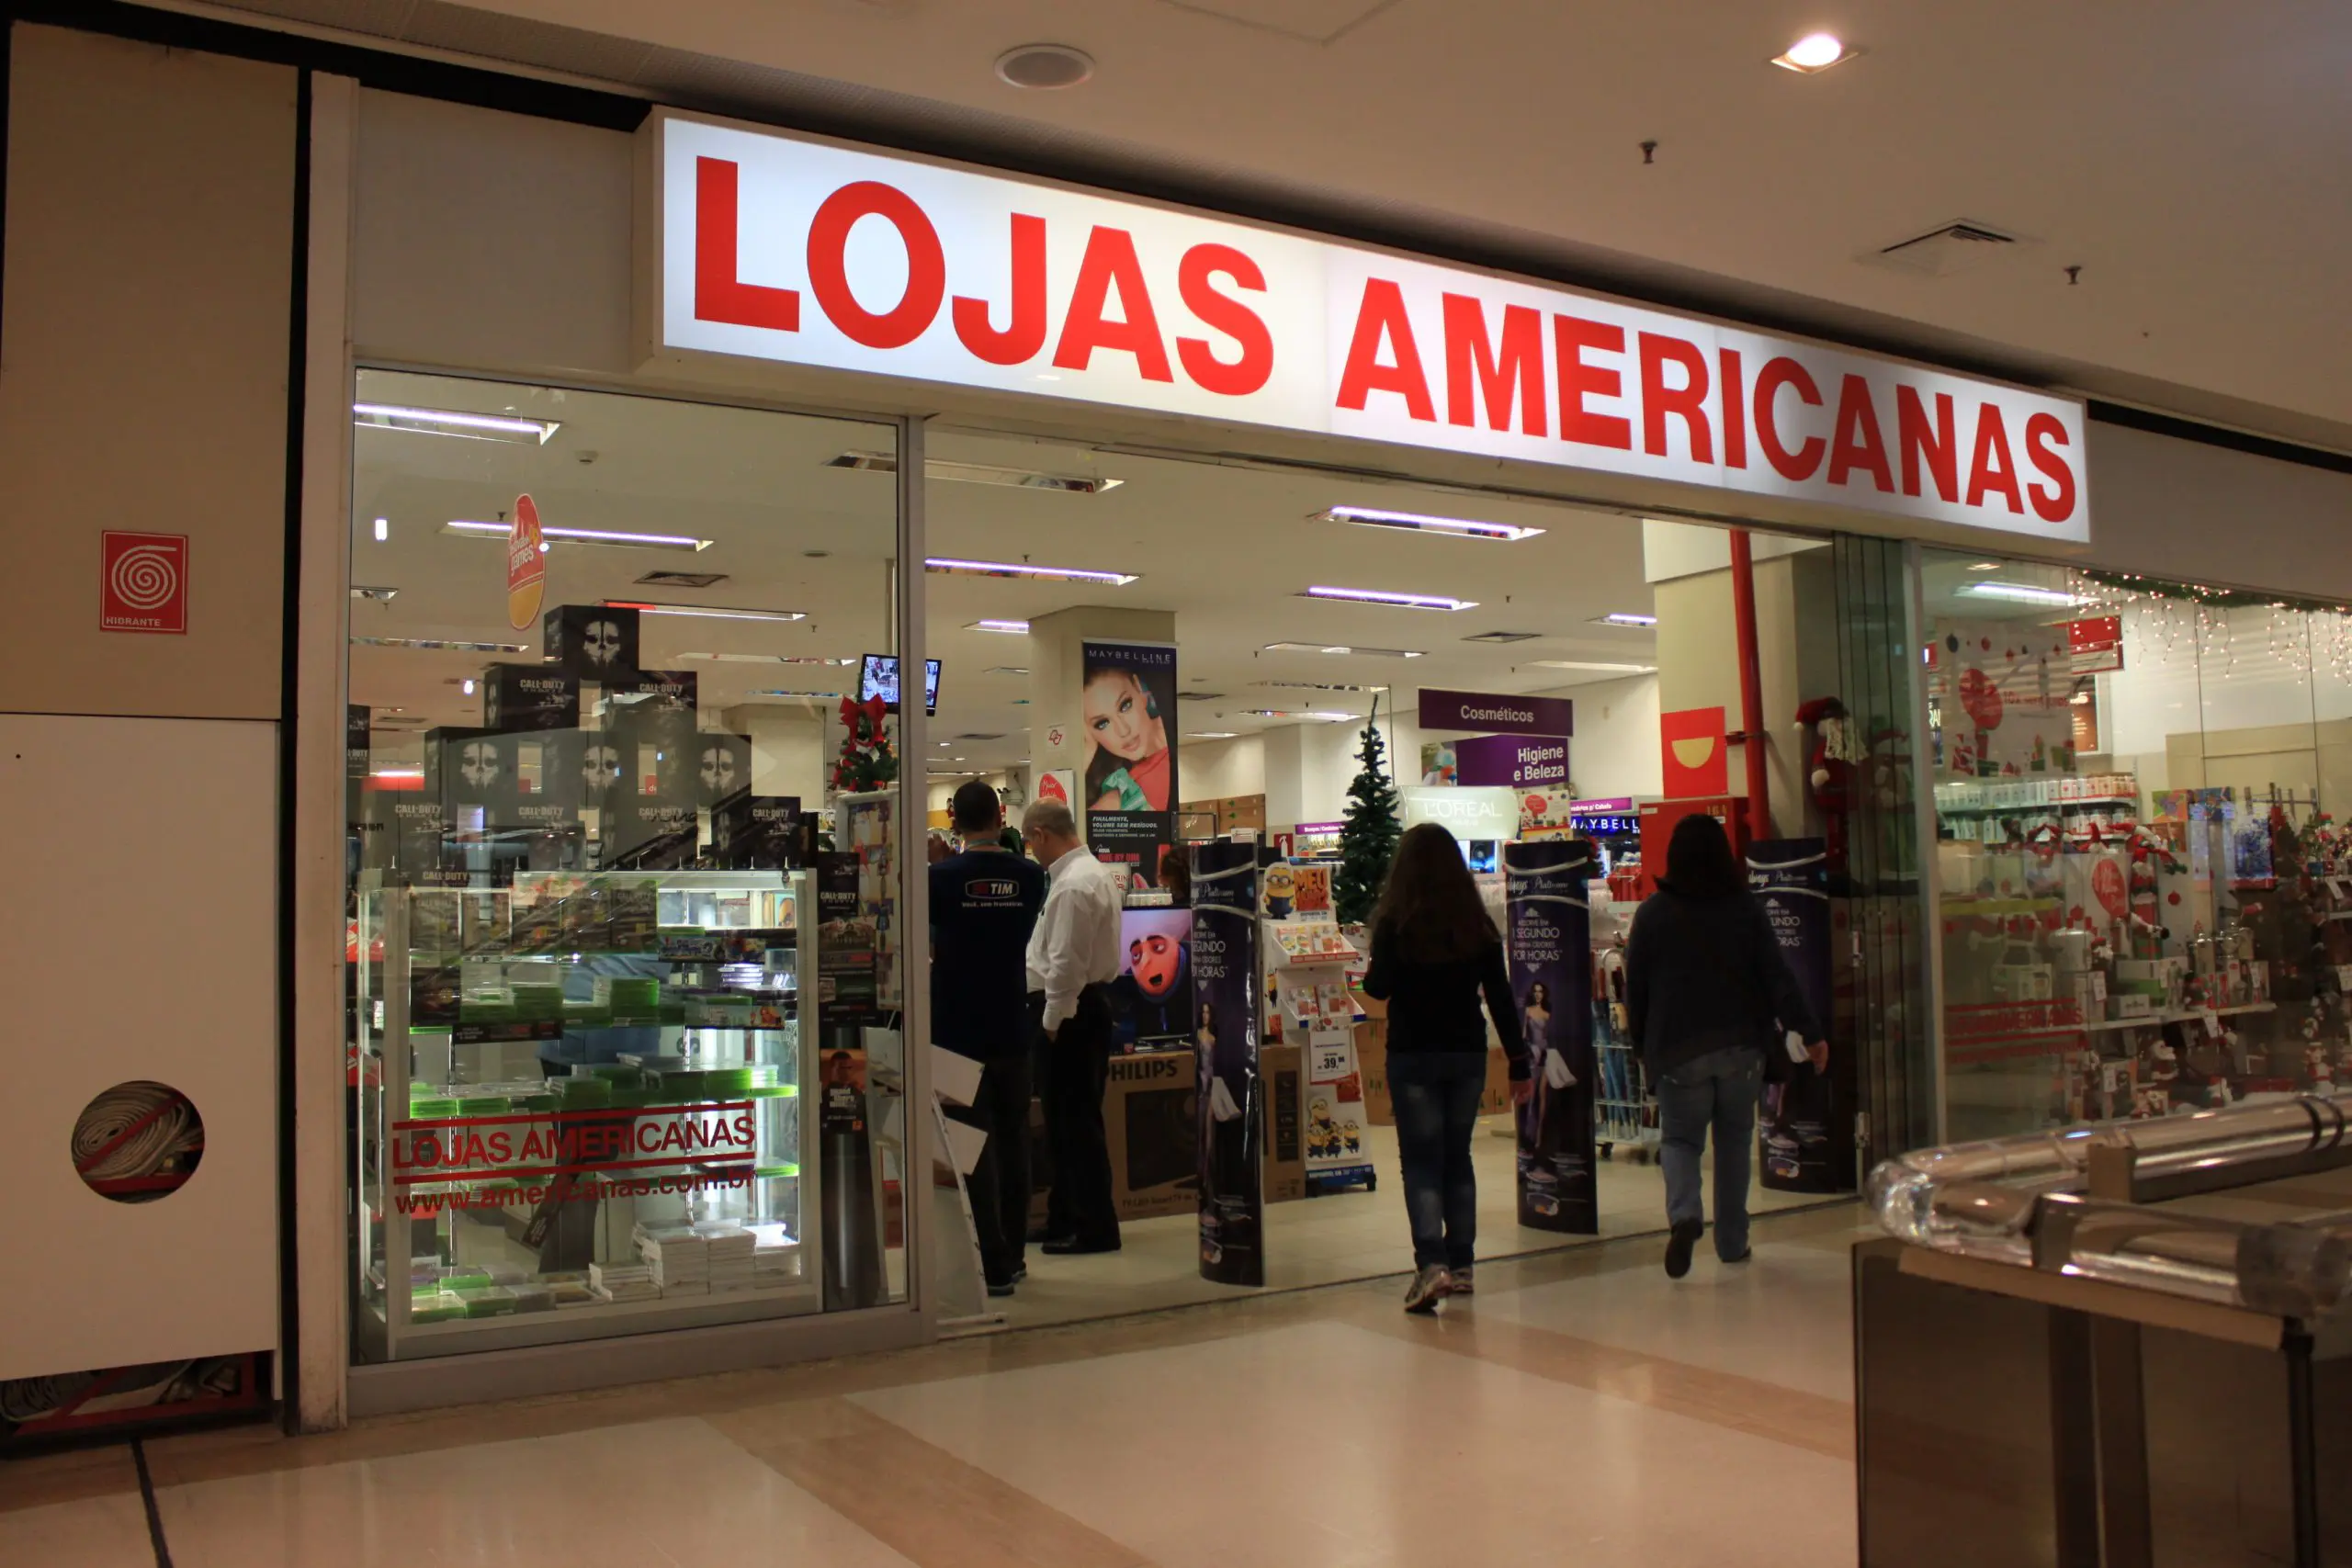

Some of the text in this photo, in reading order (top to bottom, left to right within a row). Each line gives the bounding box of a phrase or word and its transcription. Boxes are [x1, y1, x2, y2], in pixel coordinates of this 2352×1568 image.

[694, 154, 2076, 524] LOJAS AMERICANAS
[106, 616, 161, 626] HIDRANTE
[1089, 649, 1171, 661] MAYBELLINE
[1460, 705, 1534, 722] Cosméticos
[1518, 746, 1564, 764] Higiene
[1513, 764, 1565, 782] e Beleza
[1570, 818, 1639, 829] MAYBELL
[990, 883, 1013, 895] TIM
[1770, 916, 1801, 927] UNDO
[1517, 927, 1560, 938] SEGUNDO
[392, 1116, 755, 1169] LOJAS AMERICANAS
[395, 1164, 756, 1214] www.americanas.com.br
